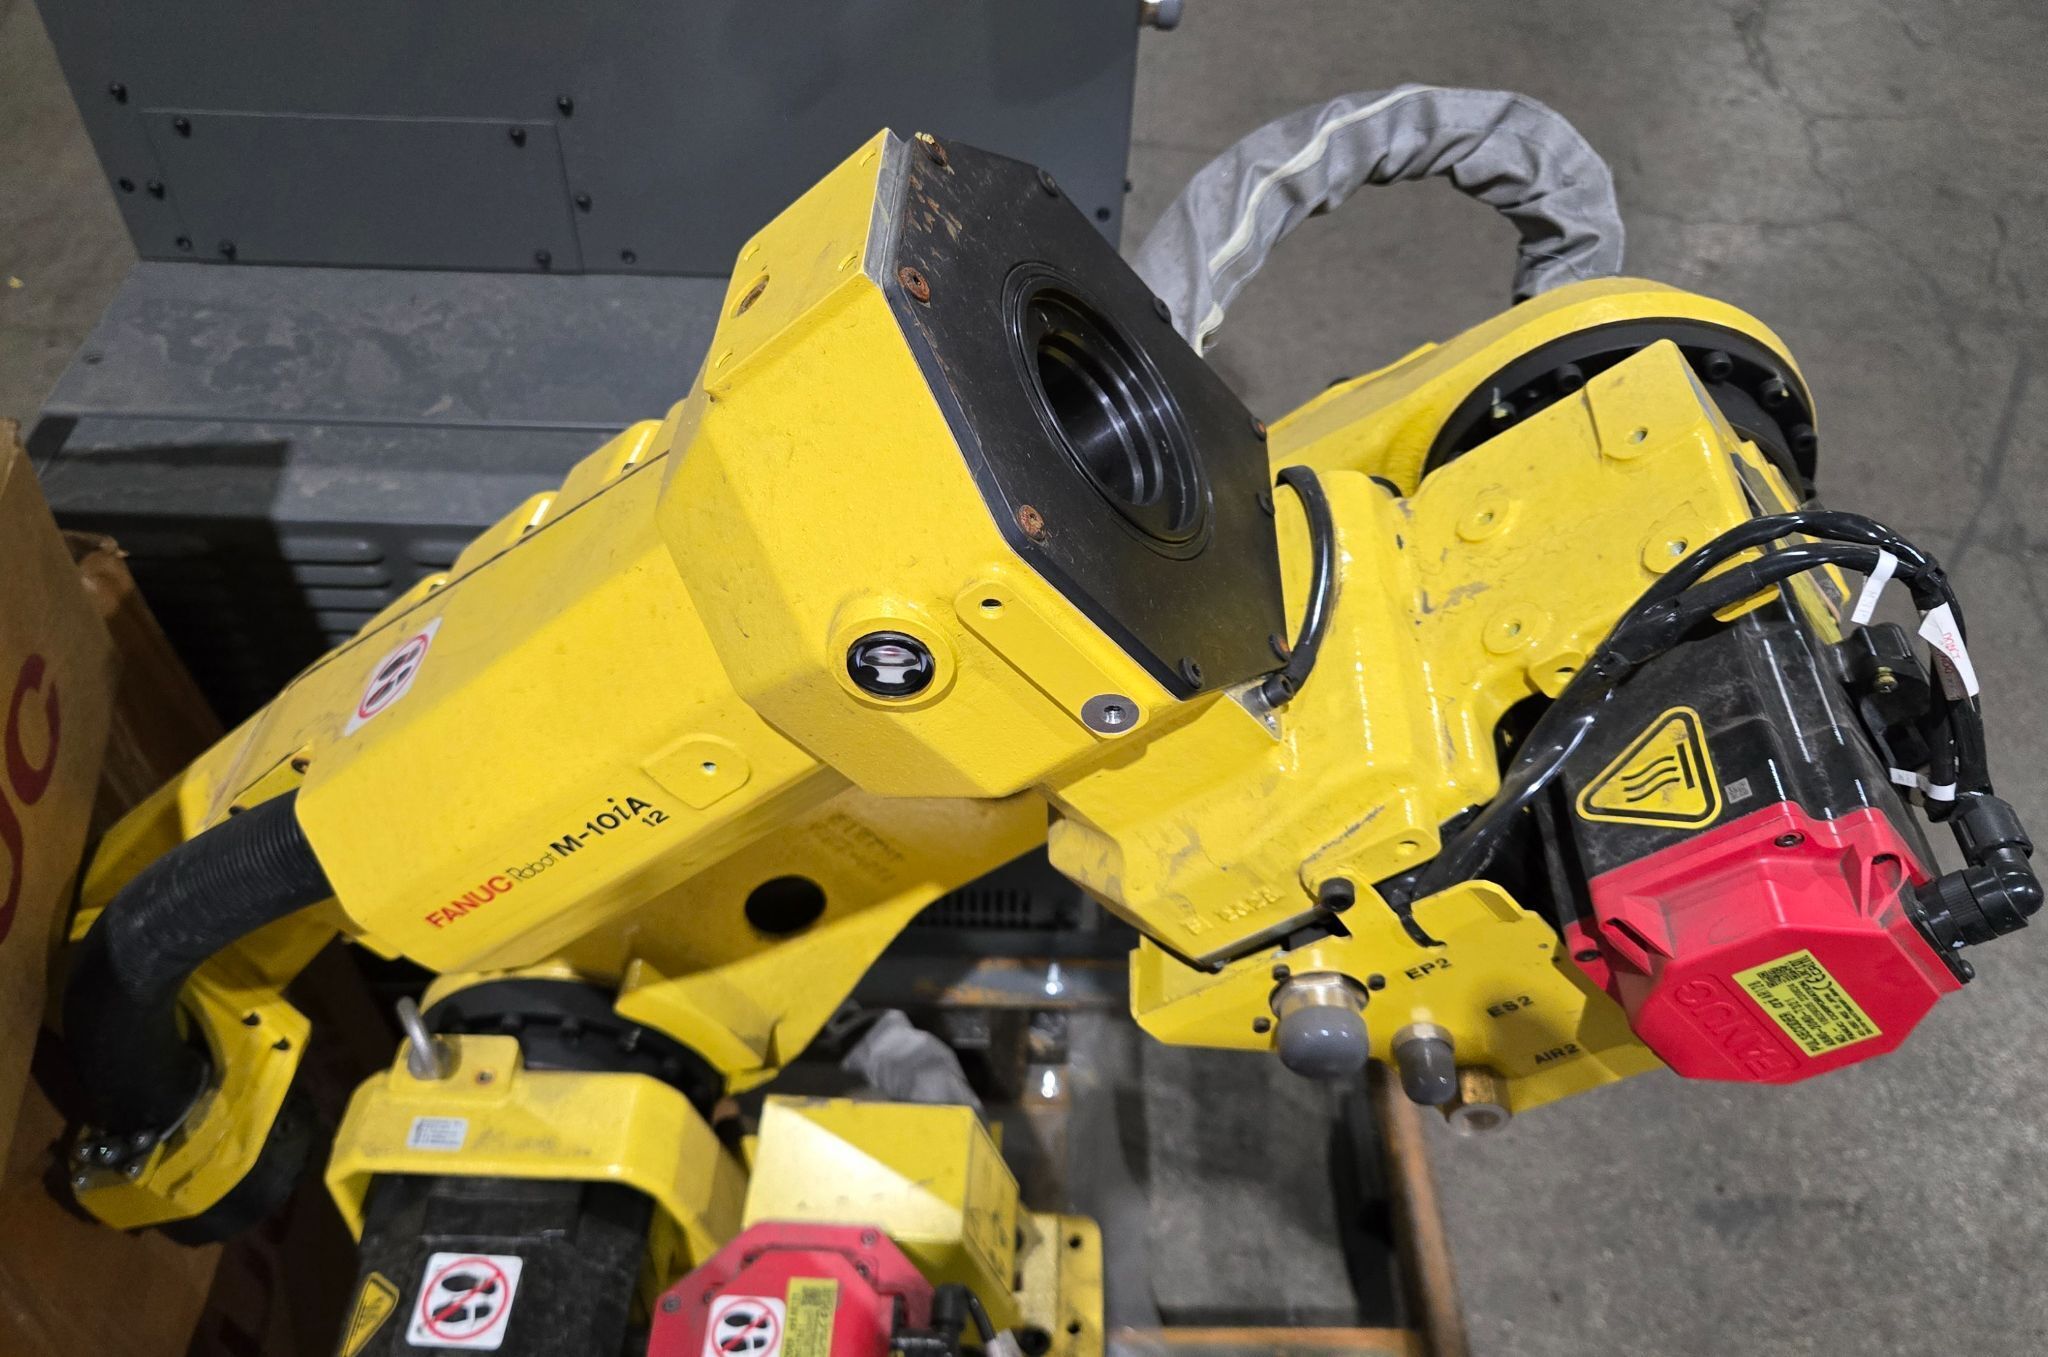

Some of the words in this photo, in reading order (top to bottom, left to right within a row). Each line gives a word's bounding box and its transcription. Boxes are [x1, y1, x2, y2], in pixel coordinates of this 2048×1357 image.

[641, 809, 670, 828] 12
[425, 875, 514, 928] FANUC
[506, 852, 559, 882] Robot
[550, 796, 652, 857] M-10iA
[1404, 957, 1452, 980] EP2
[1487, 995, 1534, 1019] ES2
[1674, 979, 1792, 1082] FANUC
[1534, 1043, 1581, 1064] AIR2
